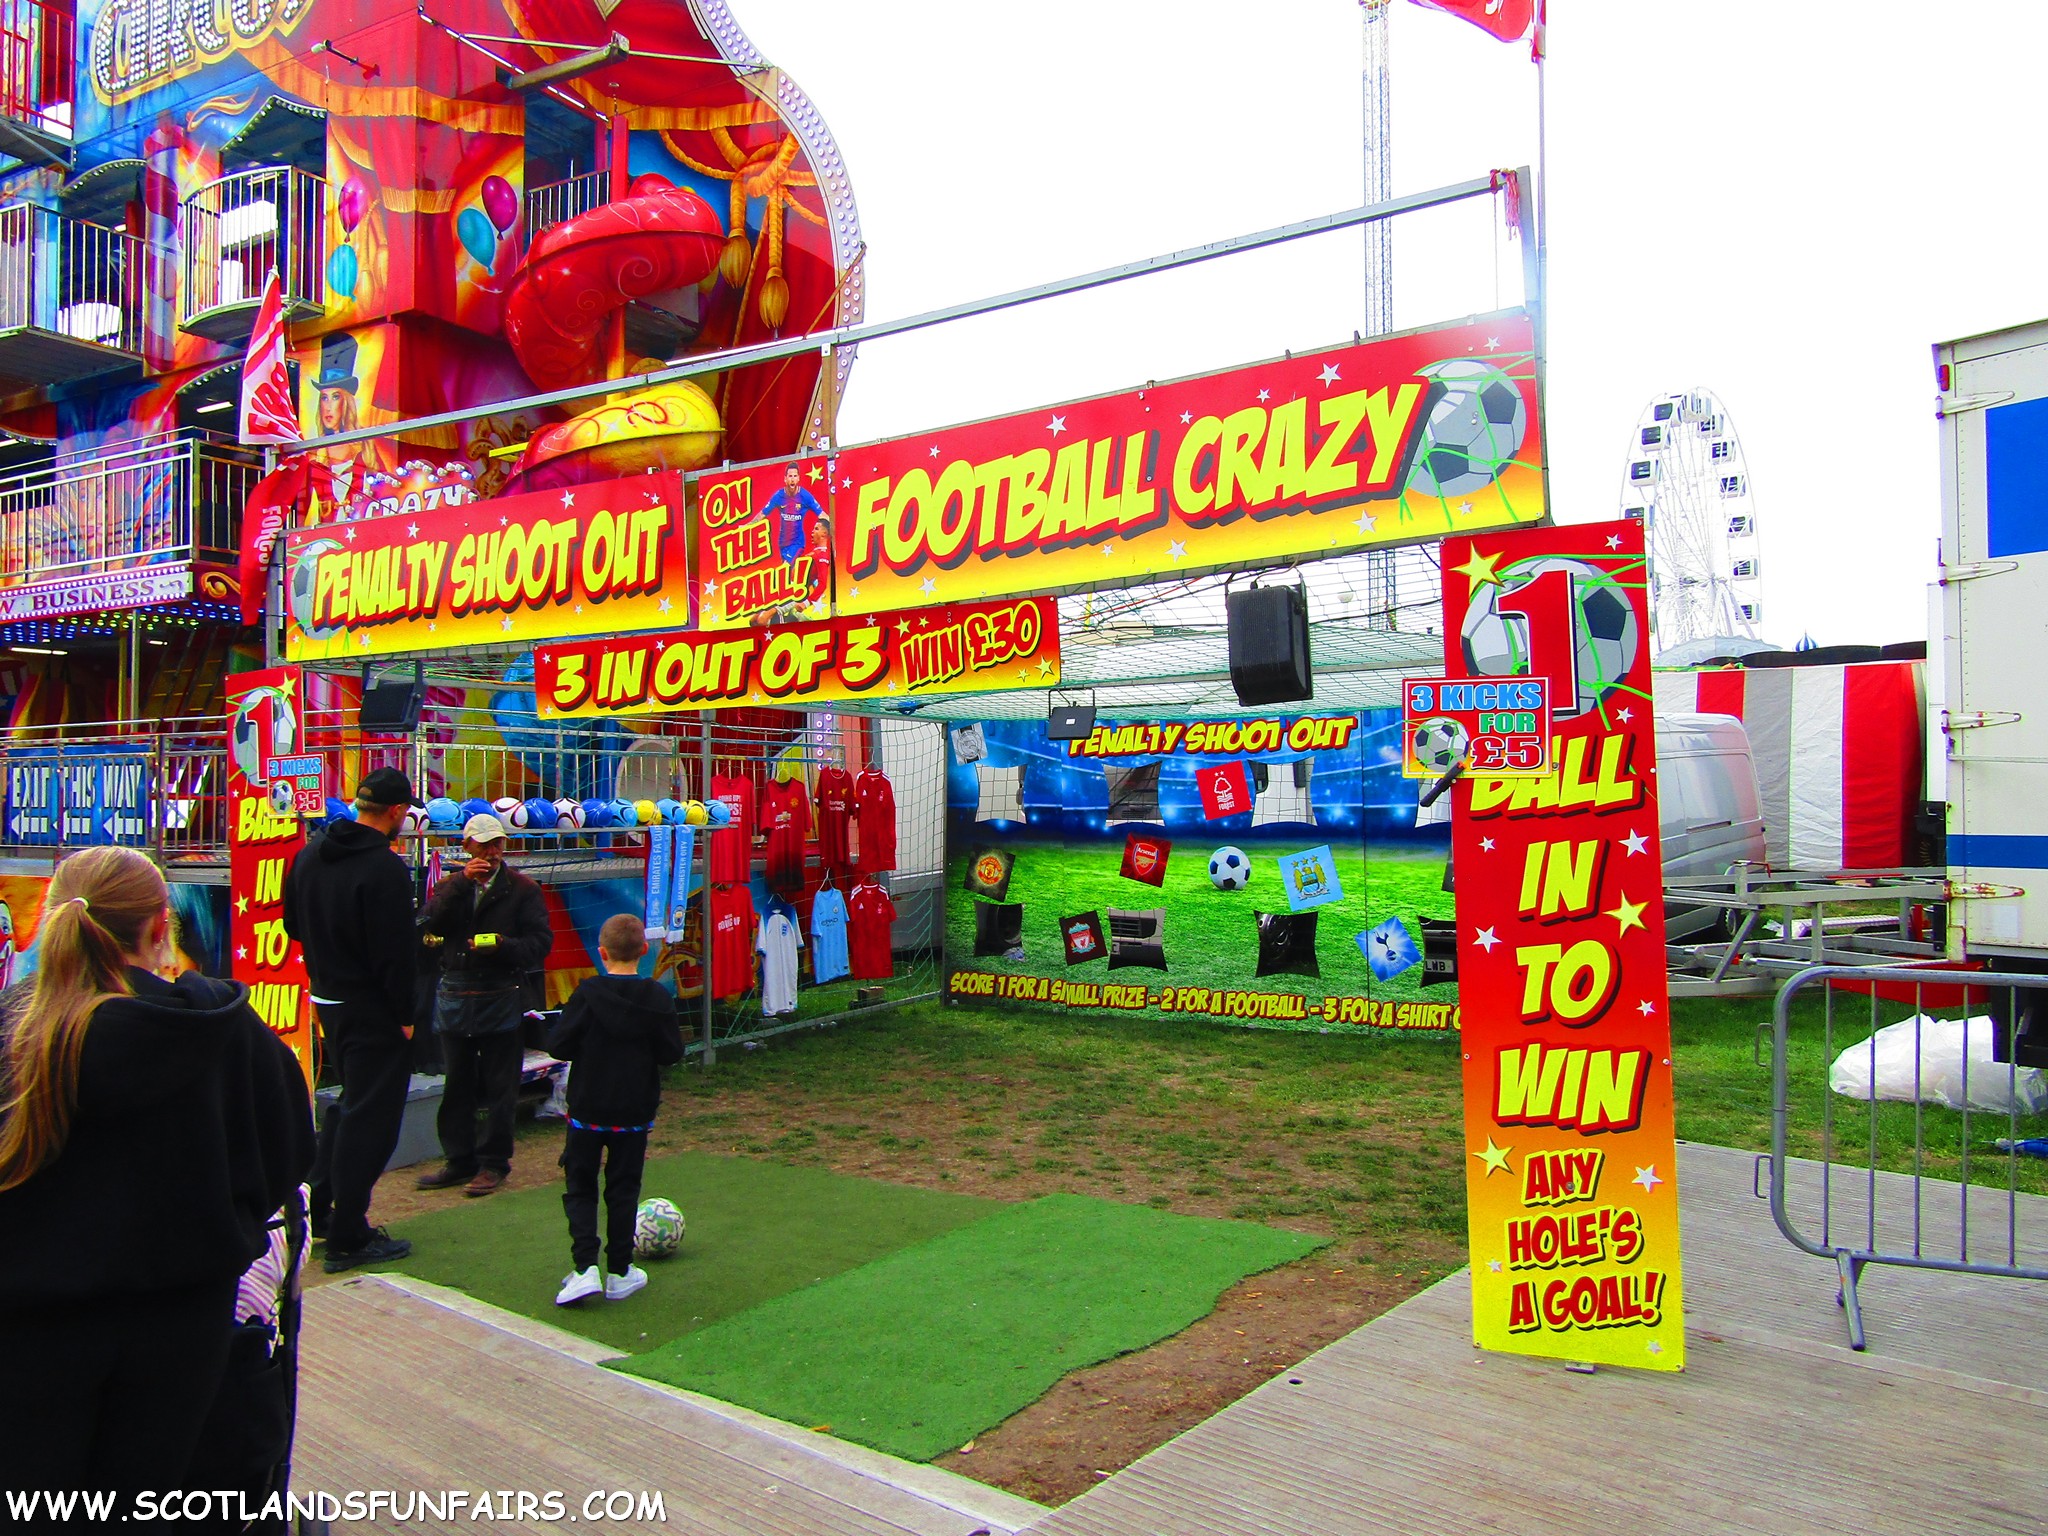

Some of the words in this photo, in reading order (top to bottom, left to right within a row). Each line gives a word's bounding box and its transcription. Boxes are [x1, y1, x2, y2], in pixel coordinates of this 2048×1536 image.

[95, 0, 300, 90] CIRC
[703, 476, 751, 528] ON
[851, 430, 1155, 567] FOOTBALL
[1173, 384, 1421, 518] CRAZY
[253, 505, 282, 572] FORE
[314, 540, 448, 621] PENALTY
[451, 518, 577, 608] SHOOT
[582, 504, 668, 593] OUT
[710, 519, 771, 573] THE
[32, 579, 154, 611] BUSINESS
[722, 556, 812, 620] BALL!
[552, 654, 586, 705] 3
[598, 647, 645, 702] IN
[655, 637, 753, 697] OUT
[761, 629, 830, 689] OF
[840, 626, 881, 683] 3
[902, 626, 963, 690] WIN
[965, 600, 1042, 670] £30
[1497, 569, 1578, 712] 1
[1411, 685, 1434, 712] 3
[1440, 683, 1542, 711] KICKS
[1478, 712, 1536, 734] FOR
[245, 694, 275, 783] 1
[1184, 720, 1282, 756] SHOOT
[1288, 717, 1358, 750] OUT
[1470, 735, 1543, 770] £5
[12, 766, 50, 808] EXIT
[60, 766, 96, 808] THIS
[103, 765, 143, 808] WAY
[269, 761, 279, 777] 3
[280, 757, 322, 777] KICKS
[297, 776, 319, 790] FOR
[293, 791, 322, 812] £5
[653, 842, 662, 853] FA
[1137, 846, 1157, 858] Arsenal
[255, 857, 285, 905] IN
[651, 855, 662, 895] EMIRATES
[677, 856, 687, 901] MANCHESTER
[1519, 839, 1598, 916] IN
[254, 918, 289, 966] TO
[950, 972, 995, 994] SCORE
[998, 977, 1006, 995] 1
[1007, 977, 1037, 998] FOR
[1037, 979, 1049, 999] A
[1102, 985, 1147, 1009] PRIZE
[1160, 989, 1173, 1009] 2
[1177, 989, 1209, 1011] FOR
[1210, 992, 1224, 1013] A
[1225, 992, 1305, 1018] FOOTBALL
[1324, 997, 1338, 1021] 3
[1340, 998, 1377, 1024] FOR
[1381, 1002, 1396, 1027] A
[1397, 1003, 1451, 1028] SHIRT
[1516, 940, 1611, 1019] TO
[1497, 1043, 1640, 1126] WIN
[1521, 1149, 1603, 1207] ANY
[1505, 1206, 1642, 1268] HOLE'S
[1508, 1281, 1540, 1332] A
[1541, 1270, 1663, 1330] GOAL!
